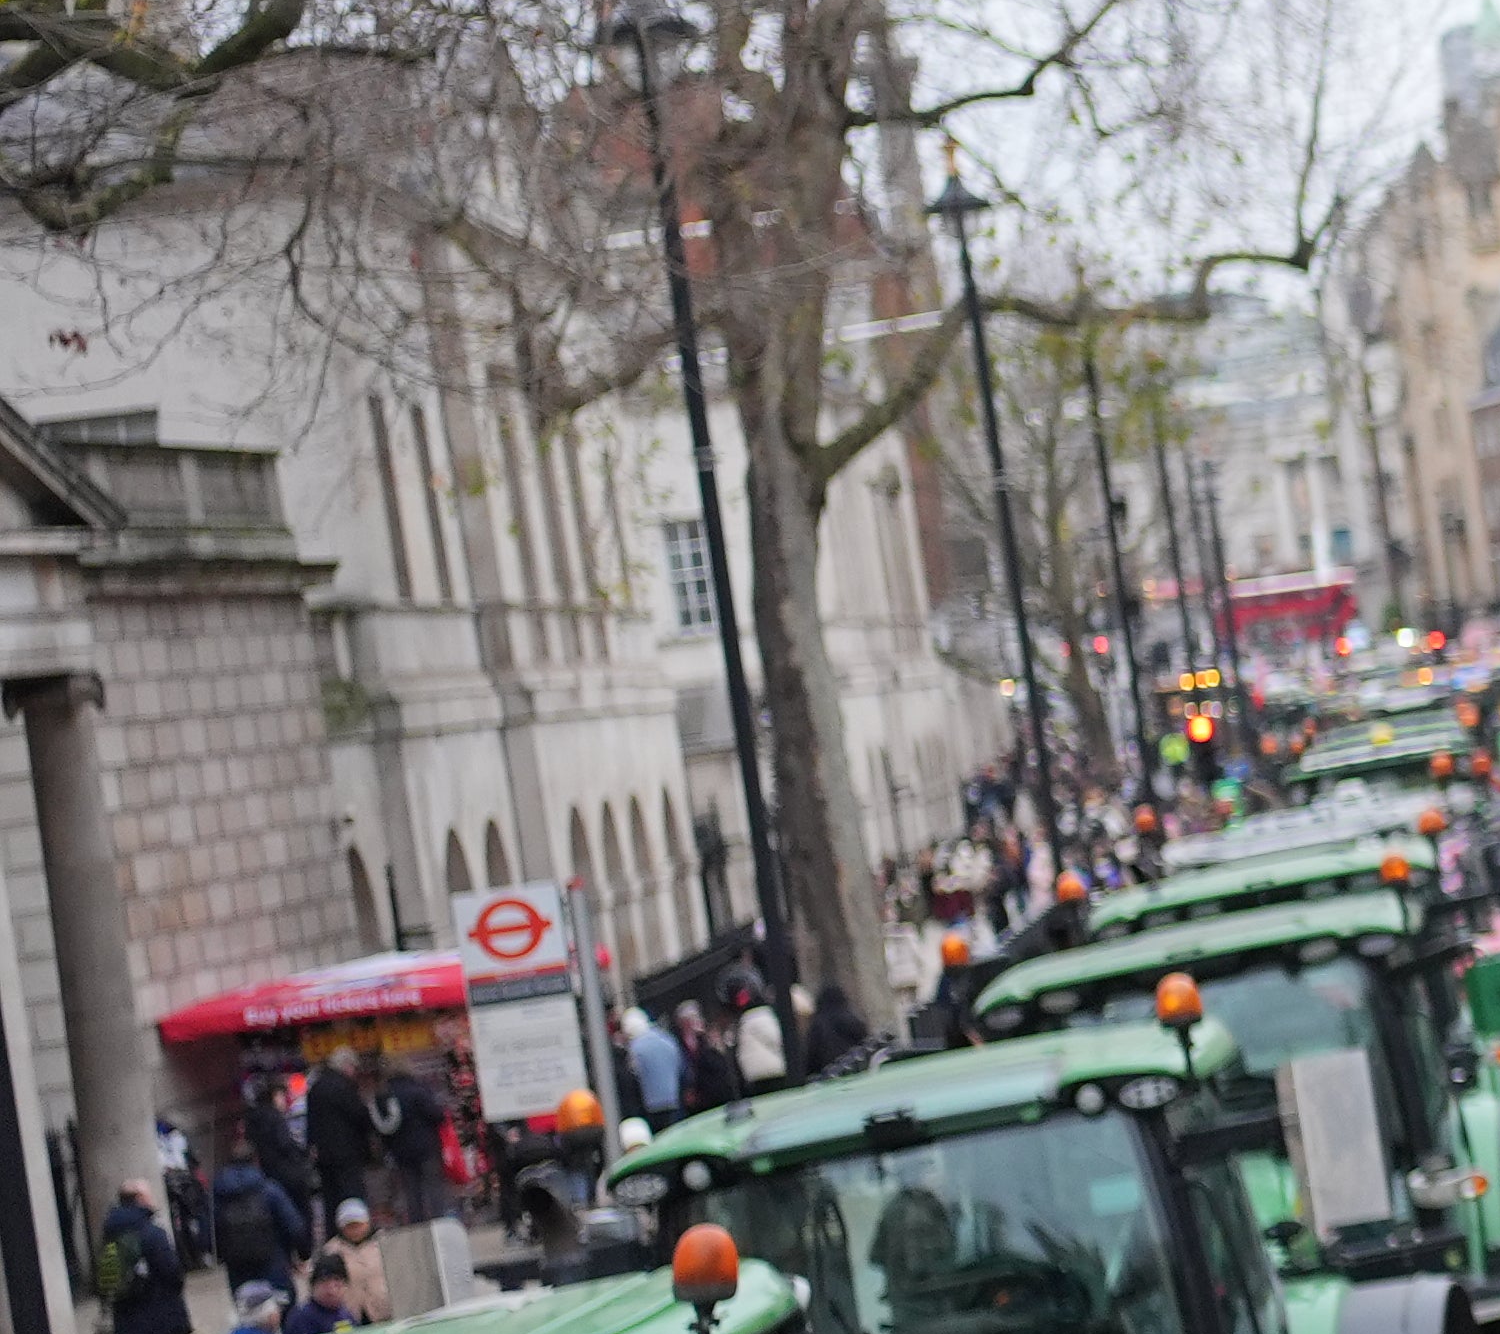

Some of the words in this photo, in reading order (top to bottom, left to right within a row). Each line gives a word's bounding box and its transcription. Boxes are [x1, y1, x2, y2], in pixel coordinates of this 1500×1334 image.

[243, 1005, 279, 1027] Buy
[281, 999, 320, 1026] your
[320, 989, 381, 1016] tickets
[381, 987, 422, 1008] here
